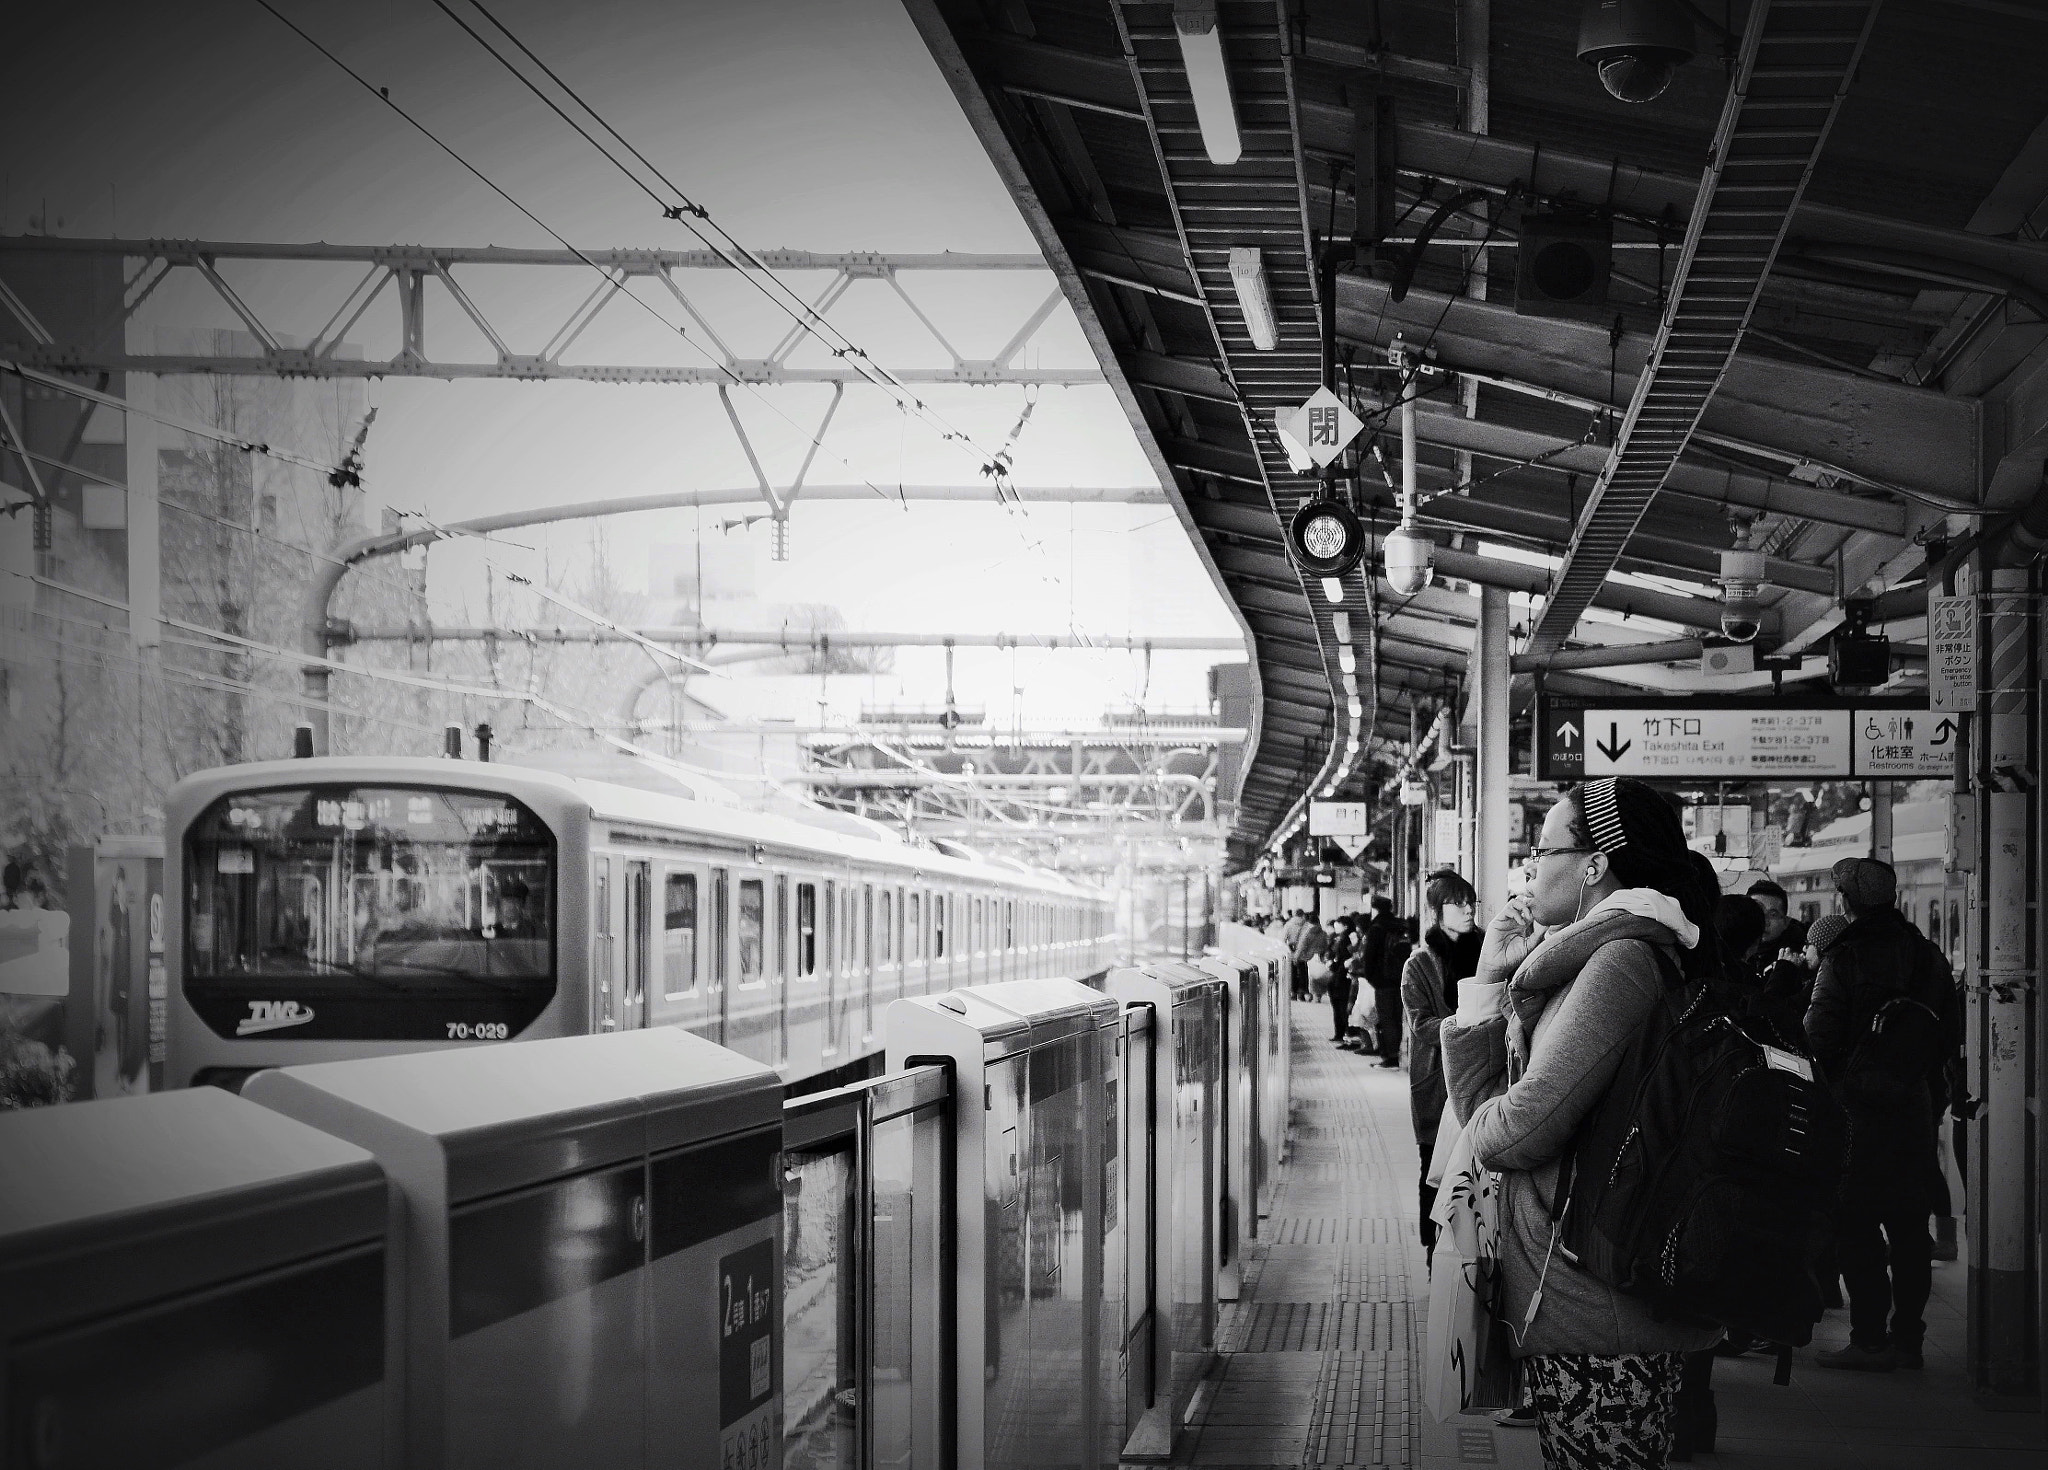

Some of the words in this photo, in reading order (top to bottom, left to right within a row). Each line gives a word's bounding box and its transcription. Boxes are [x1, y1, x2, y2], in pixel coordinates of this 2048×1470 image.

[1308, 406, 1339, 447] 閉
[1935, 643, 1971, 654] 非常停止
[1944, 656, 1972, 666] ボタン
[1940, 667, 1972, 675] Emergency
[1643, 717, 1701, 736] 竹下口
[1642, 740, 1699, 751] Takeshita
[1703, 740, 1724, 751] Exit
[1870, 745, 1914, 760] 化粧室
[1868, 761, 1914, 770] Restrooms
[446, 1022, 509, 1039] 70-029
